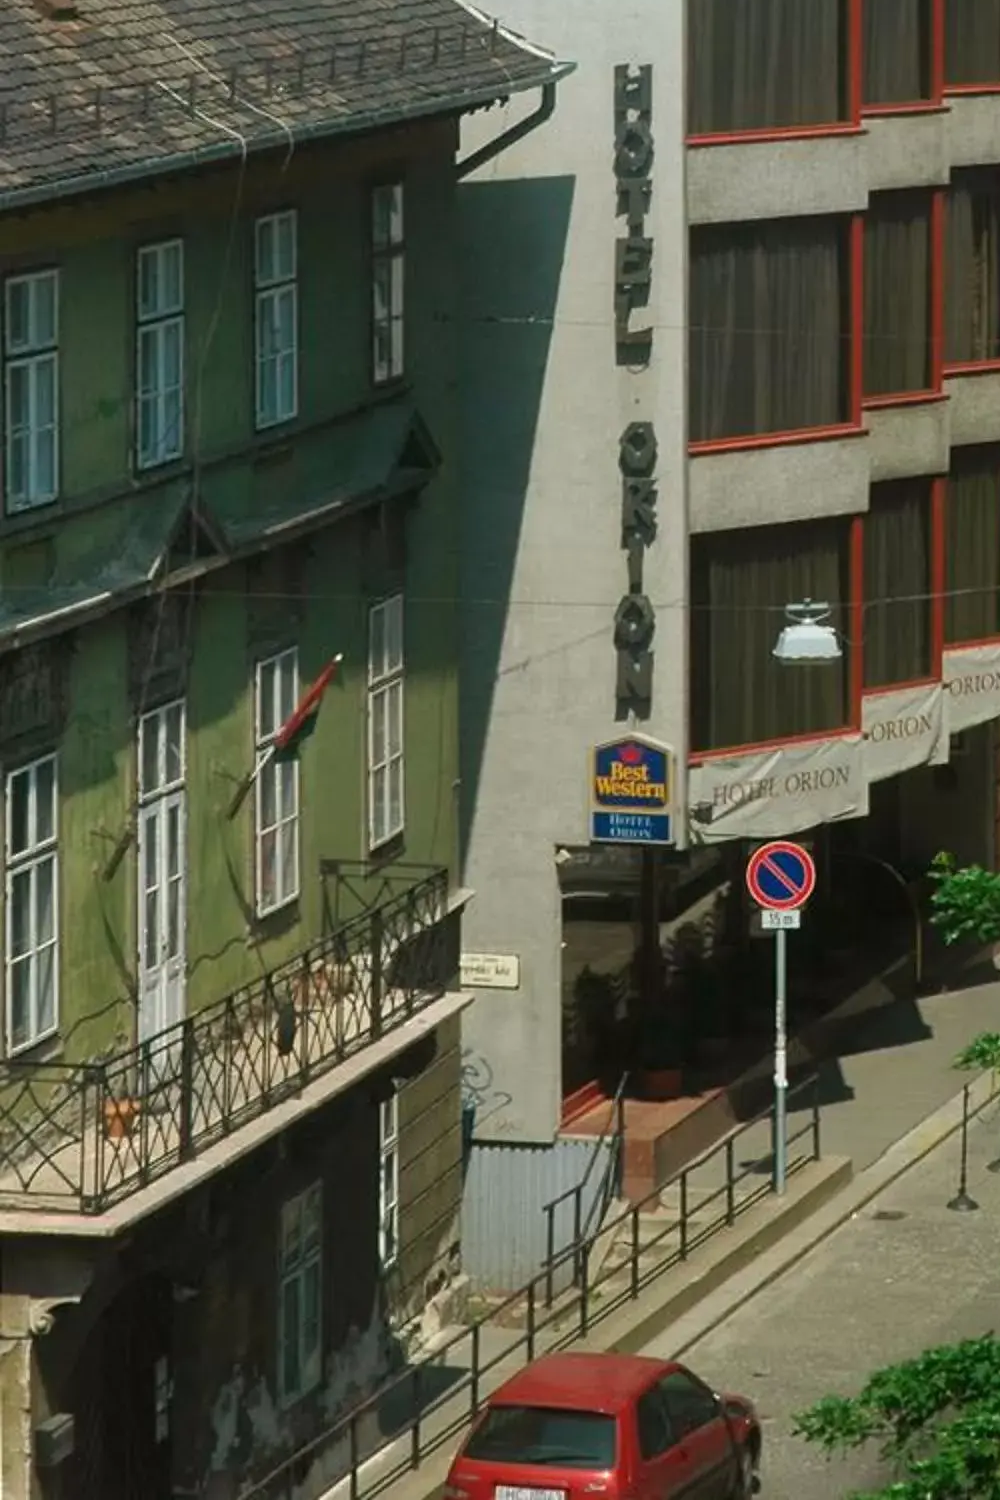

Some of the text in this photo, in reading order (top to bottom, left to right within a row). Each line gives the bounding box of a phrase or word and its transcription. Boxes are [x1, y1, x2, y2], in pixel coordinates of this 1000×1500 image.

[613, 64, 658, 722] HOTEL ORION
[871, 713, 932, 743] ORION
[611, 761, 649, 782] Best
[713, 765, 850, 804] HOTEL ORION
[596, 776, 665, 799] Western
